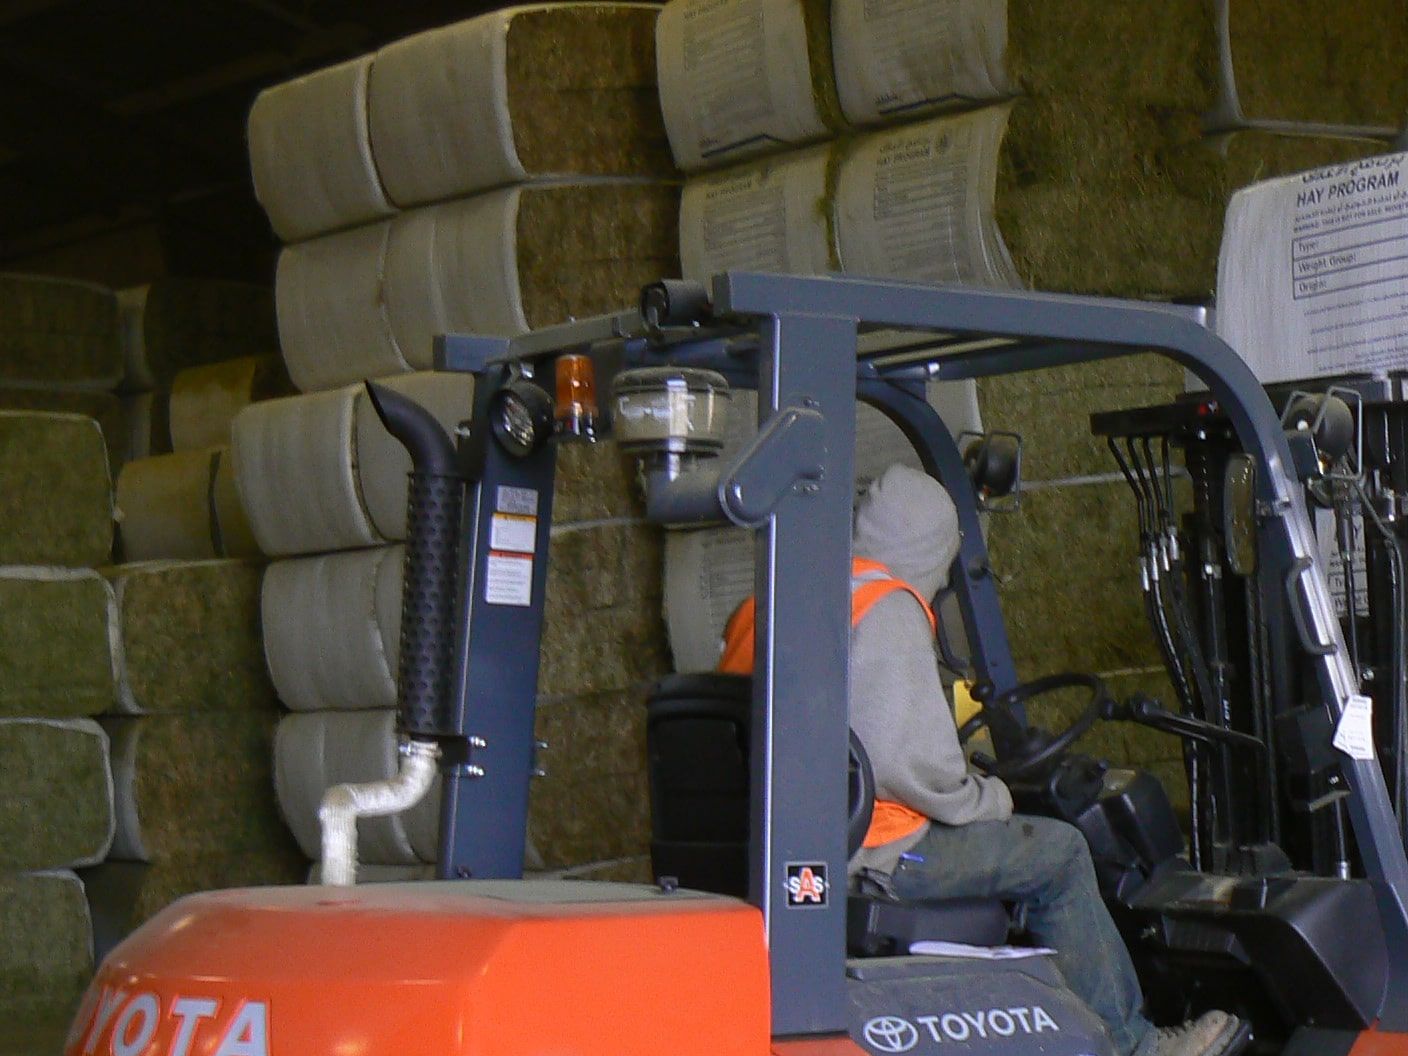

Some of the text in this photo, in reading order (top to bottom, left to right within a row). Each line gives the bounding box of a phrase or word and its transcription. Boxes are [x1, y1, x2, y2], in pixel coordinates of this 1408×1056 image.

[1297, 171, 1399, 208] HAY PROGRAM
[916, 1005, 1060, 1043] TOYOTA
